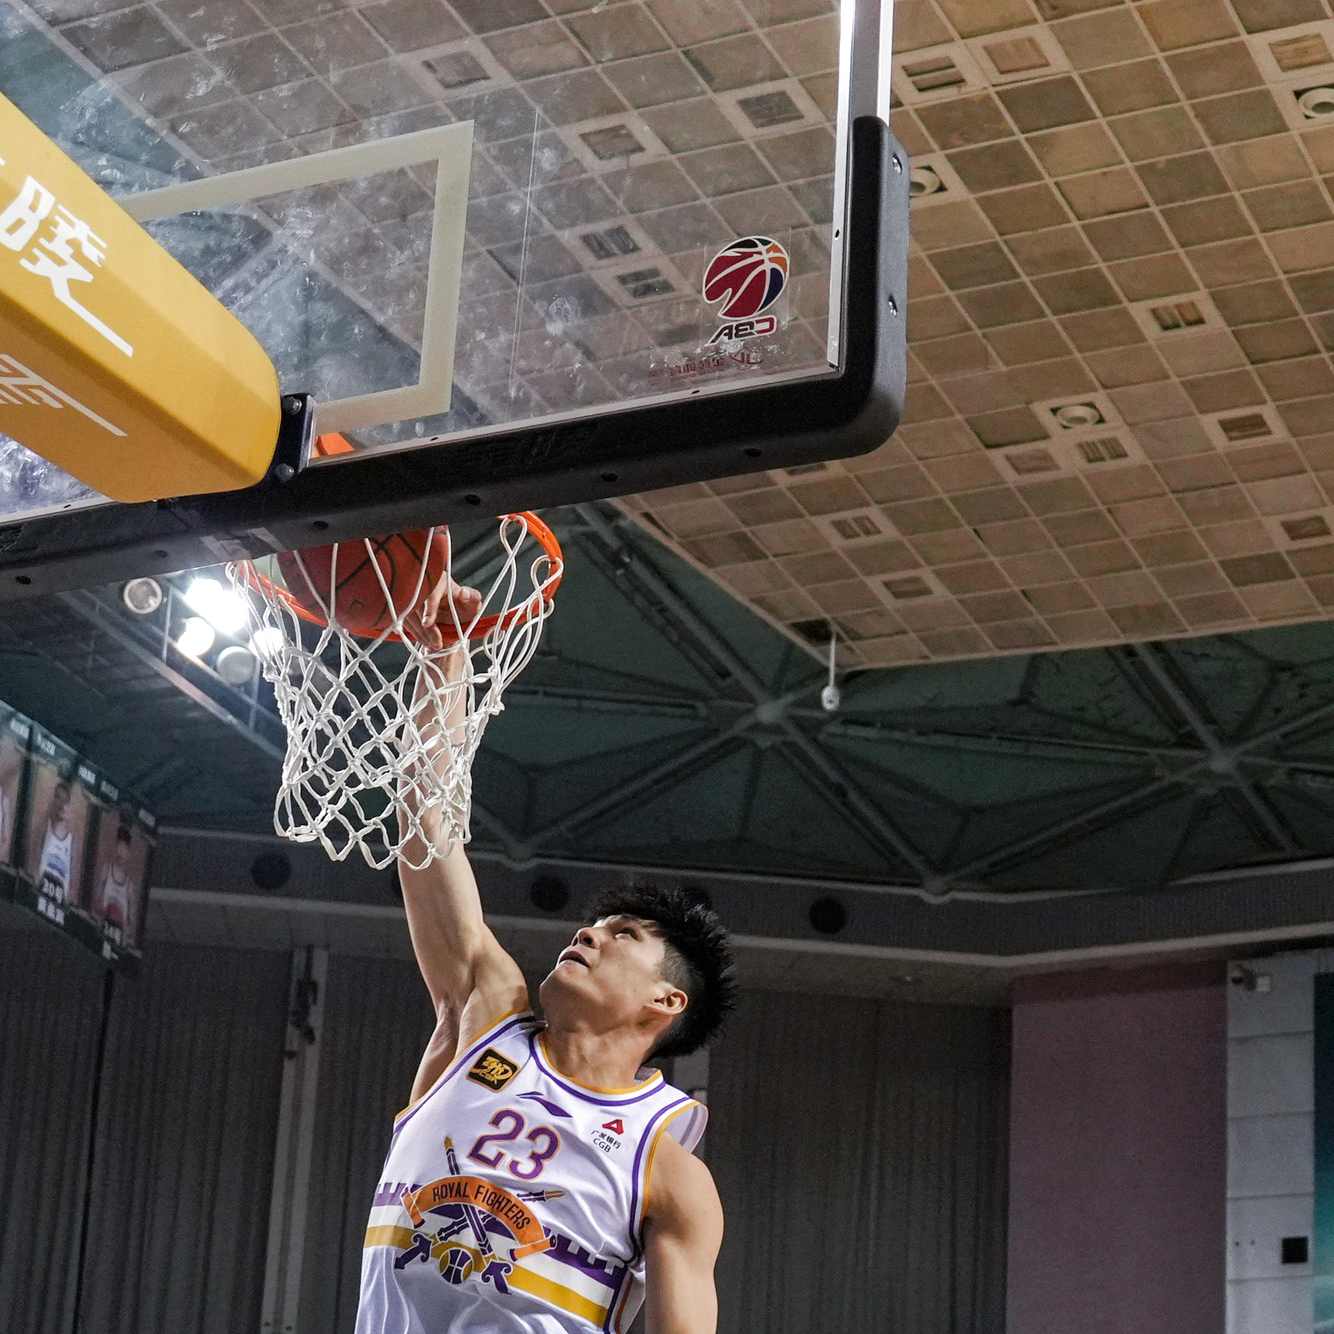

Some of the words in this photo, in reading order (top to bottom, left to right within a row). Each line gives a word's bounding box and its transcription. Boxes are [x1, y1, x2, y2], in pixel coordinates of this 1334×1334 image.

[467, 1107, 560, 1182] 23
[591, 1138, 612, 1154] CGB
[431, 1182, 471, 1203] ROYAL
[473, 1182, 533, 1230] FIGHTERS
